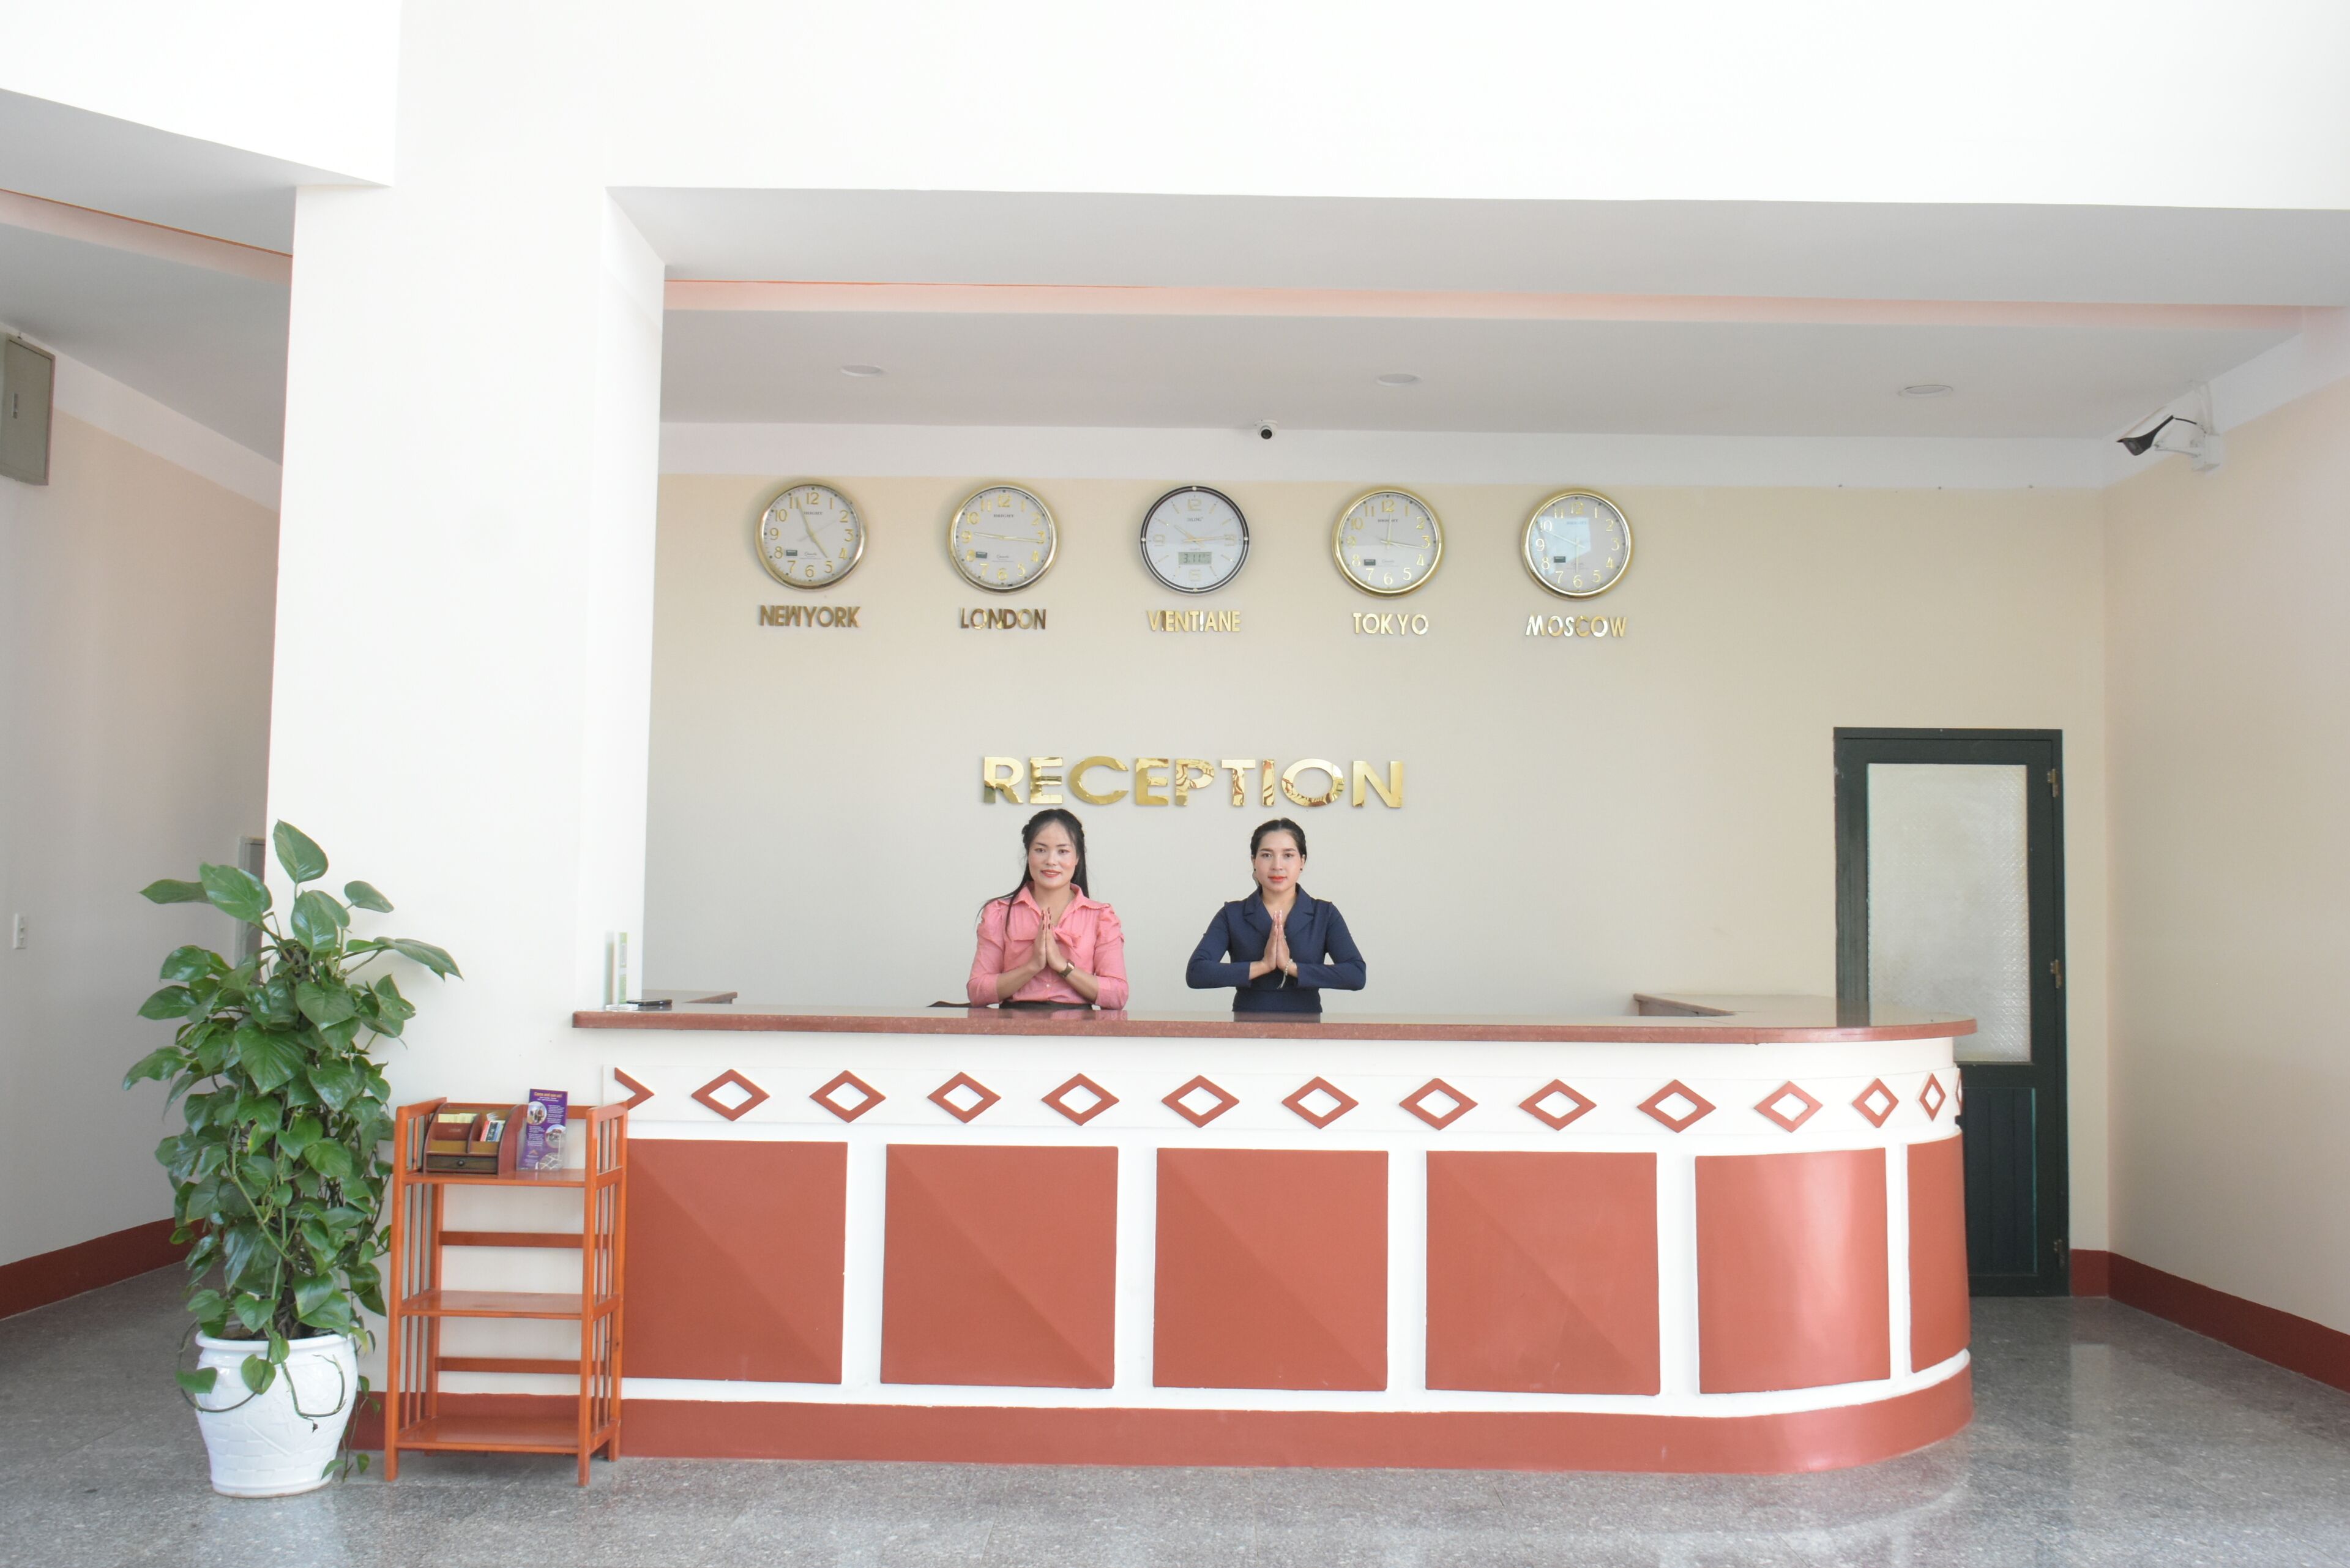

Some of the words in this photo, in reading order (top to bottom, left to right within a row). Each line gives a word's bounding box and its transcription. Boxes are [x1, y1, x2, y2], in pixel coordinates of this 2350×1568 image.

[807, 492, 819, 504] 12
[830, 498, 833, 509] 1
[998, 495, 1010, 507] 12
[981, 499, 991, 512] 11
[1021, 500, 1025, 512] 1
[1365, 506, 1374, 517] 11
[1382, 500, 1394, 512] 12
[1405, 505, 1409, 517] 1
[1571, 501, 1583, 514] 12
[775, 509, 787, 521] 10
[840, 510, 848, 523] 2
[967, 512, 979, 525] 10
[1594, 507, 1597, 518] 1
[1351, 518, 1363, 529] 10
[1416, 517, 1424, 529] 2
[1540, 520, 1552, 532] 10
[1606, 519, 1613, 531] 2
[770, 528, 779, 540] 9
[845, 529, 853, 542] 3
[961, 531, 971, 543] 9
[1422, 536, 1430, 548] 3
[1536, 539, 1545, 551] 9
[774, 547, 783, 558] 8
[839, 548, 847, 559] 4
[1032, 551, 1039, 562] 4
[1352, 554, 1360, 566] 8
[1417, 554, 1424, 566] 4
[1542, 557, 1549, 569] 8
[1606, 557, 1613, 569] 4
[788, 561, 796, 573] 7
[805, 565, 814, 577] 6
[825, 561, 832, 573] 5
[980, 564, 988, 575] 7
[1018, 564, 1025, 576] 5
[998, 568, 1007, 580] 6
[1366, 568, 1374, 580] 7
[1384, 573, 1393, 585] 6
[1403, 568, 1411, 580] 5
[1556, 571, 1564, 583] 7
[1593, 570, 1601, 583] 5
[1573, 575, 1582, 588] 6
[759, 605, 861, 627] NEWYORK
[961, 608, 1046, 629] LONDON
[1353, 613, 1429, 635] TOKYO
[1525, 615, 1628, 637] MOSCOW
[983, 756, 1403, 808] RECEPTION
